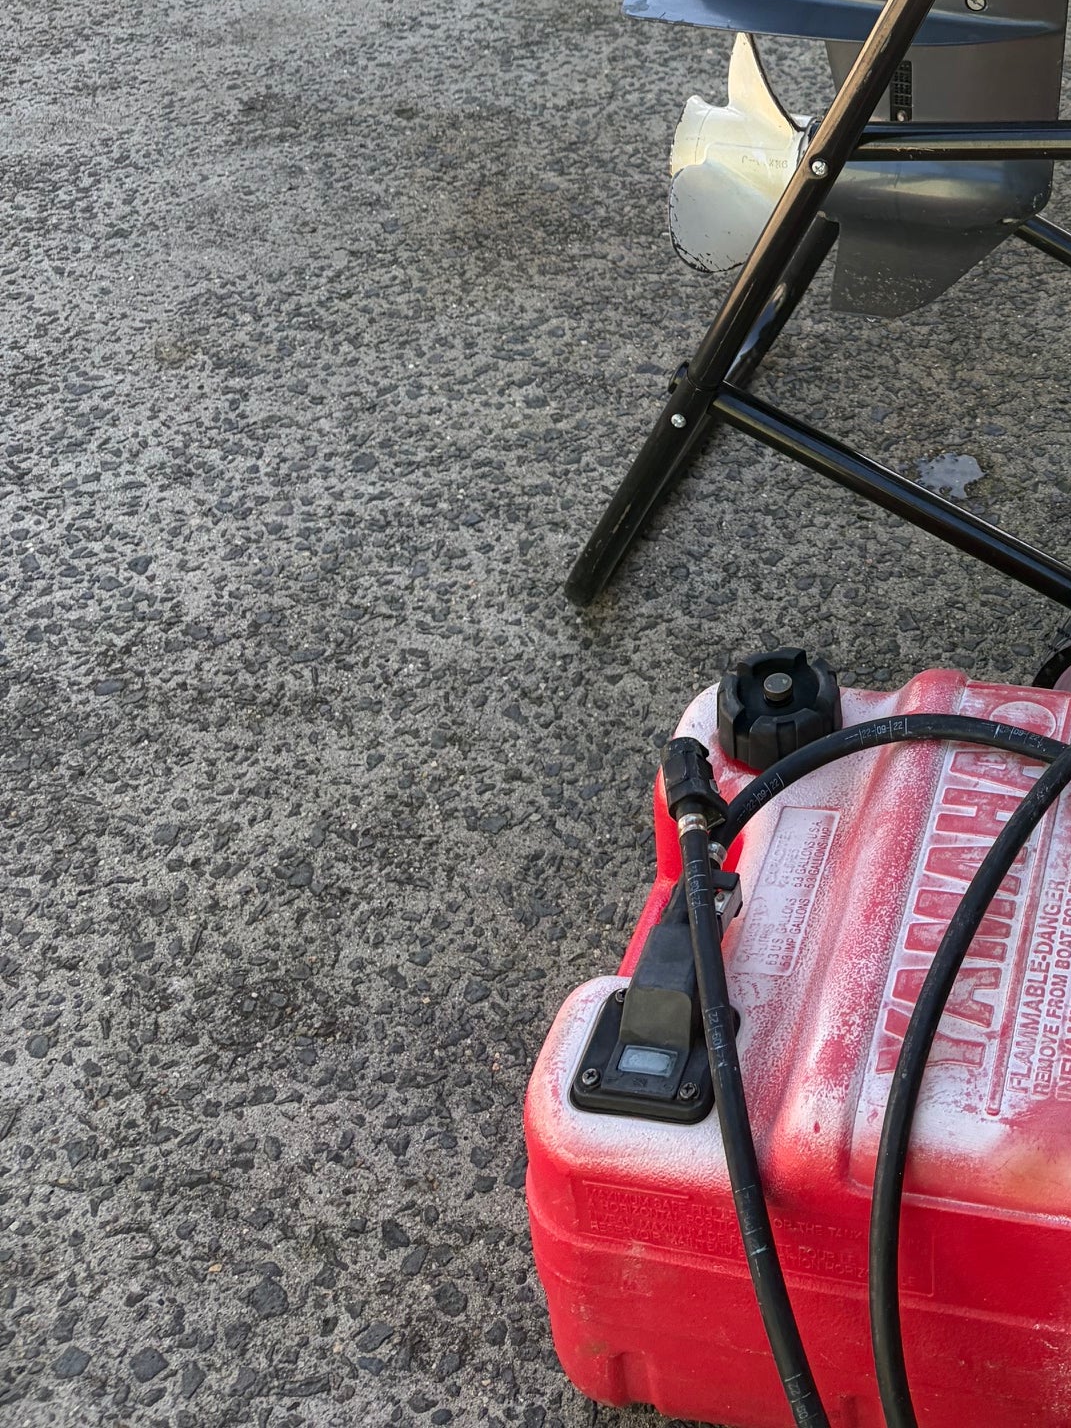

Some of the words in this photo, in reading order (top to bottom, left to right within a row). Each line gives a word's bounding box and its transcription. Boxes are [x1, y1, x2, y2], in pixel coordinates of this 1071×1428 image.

[794, 840, 815, 874] GALLONS
[788, 897, 810, 934] GALLONS
[873, 744, 1050, 1080] YAMAHA
[1005, 879, 1067, 1093] FLAMMABLE-DANGER
[1044, 973, 1069, 1019] FROM
[1030, 1023, 1060, 1095] REMOVE
